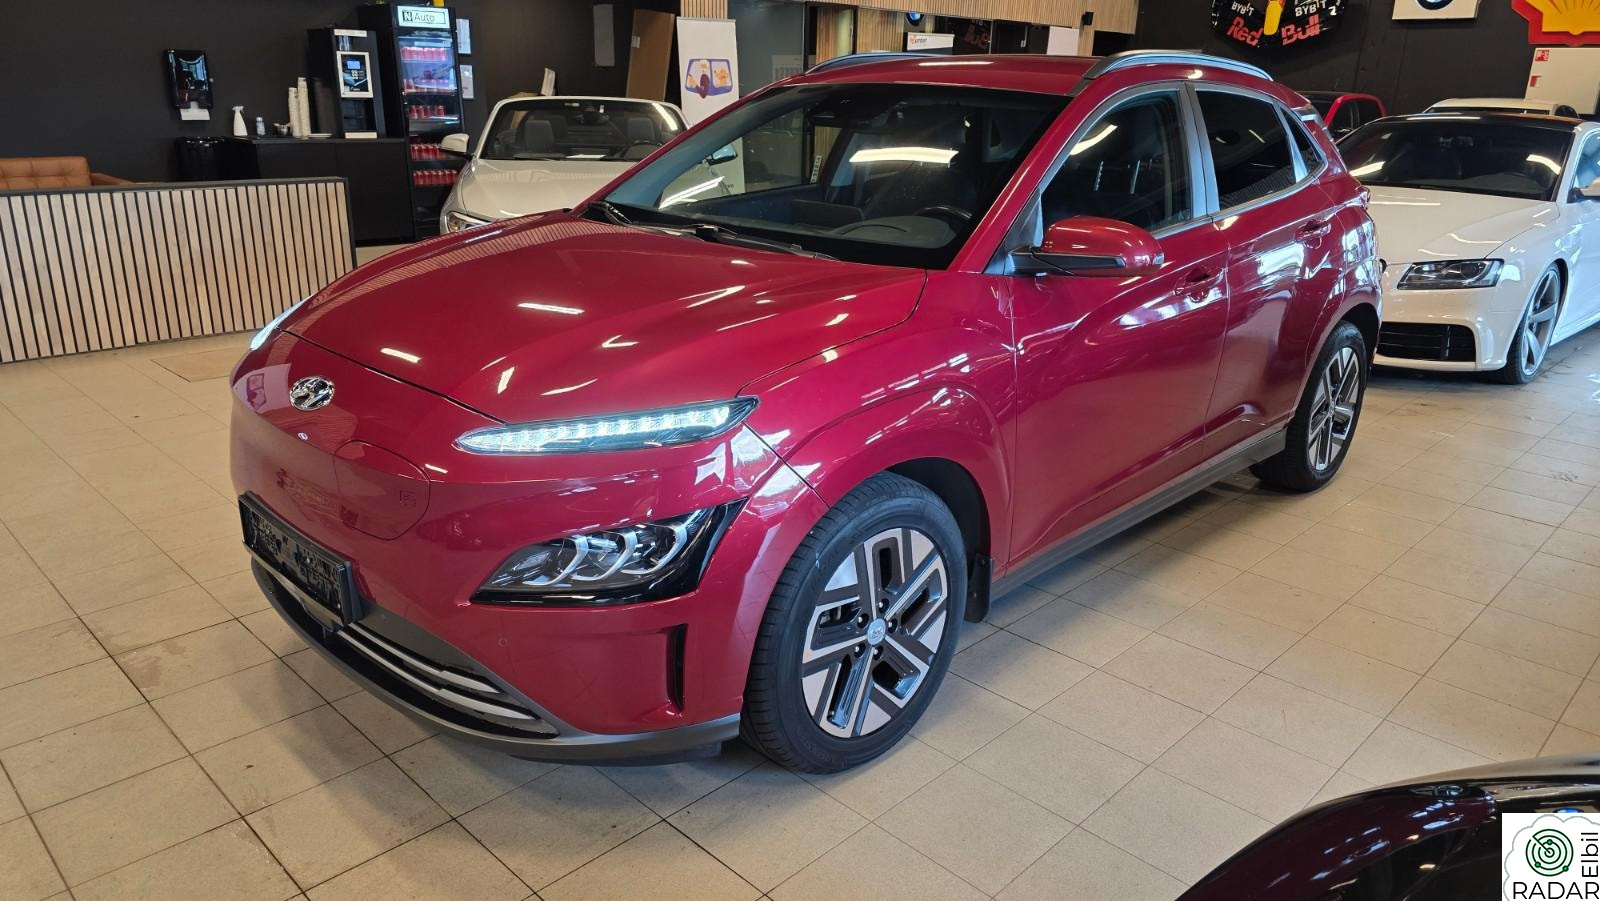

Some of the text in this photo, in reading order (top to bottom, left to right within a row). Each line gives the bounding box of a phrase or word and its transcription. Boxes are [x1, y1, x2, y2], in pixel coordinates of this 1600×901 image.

[1231, 1, 1255, 16] BYBIT
[1295, 0, 1327, 17] BYBIT
[414, 12, 436, 22] Auto
[1226, 14, 1320, 46] Red Bull
